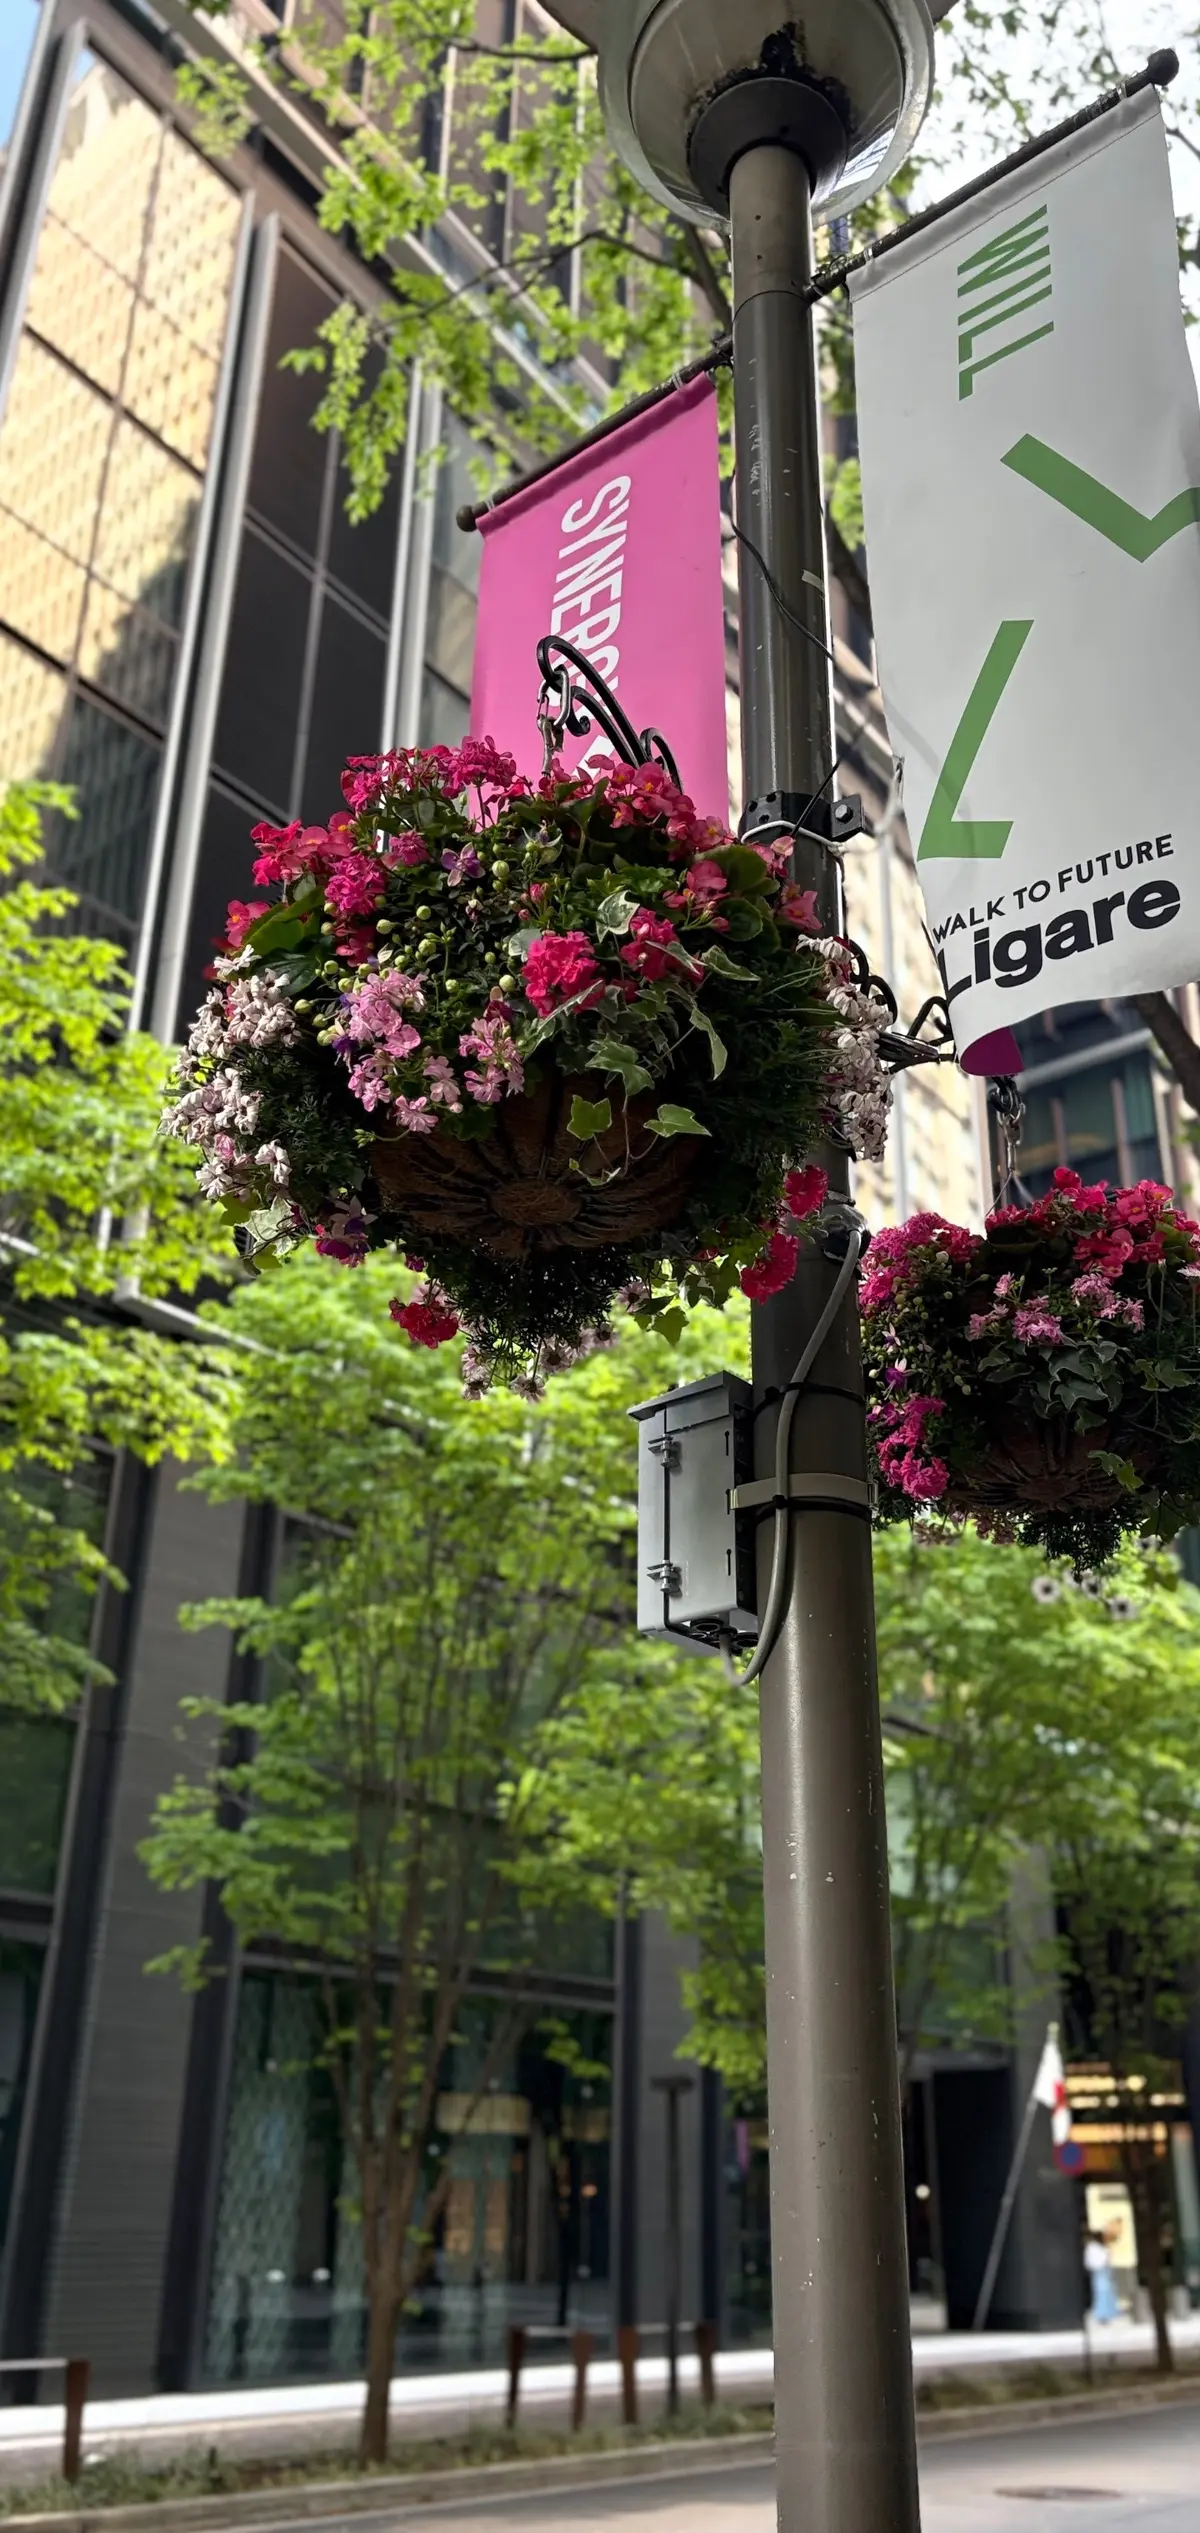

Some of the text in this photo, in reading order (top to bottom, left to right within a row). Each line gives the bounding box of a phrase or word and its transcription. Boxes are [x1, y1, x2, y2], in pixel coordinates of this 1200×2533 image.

[957, 204, 1055, 401] WILL
[932, 834, 1175, 944] WALK TO FUTURE
[937, 880, 1181, 1001] Ligare
